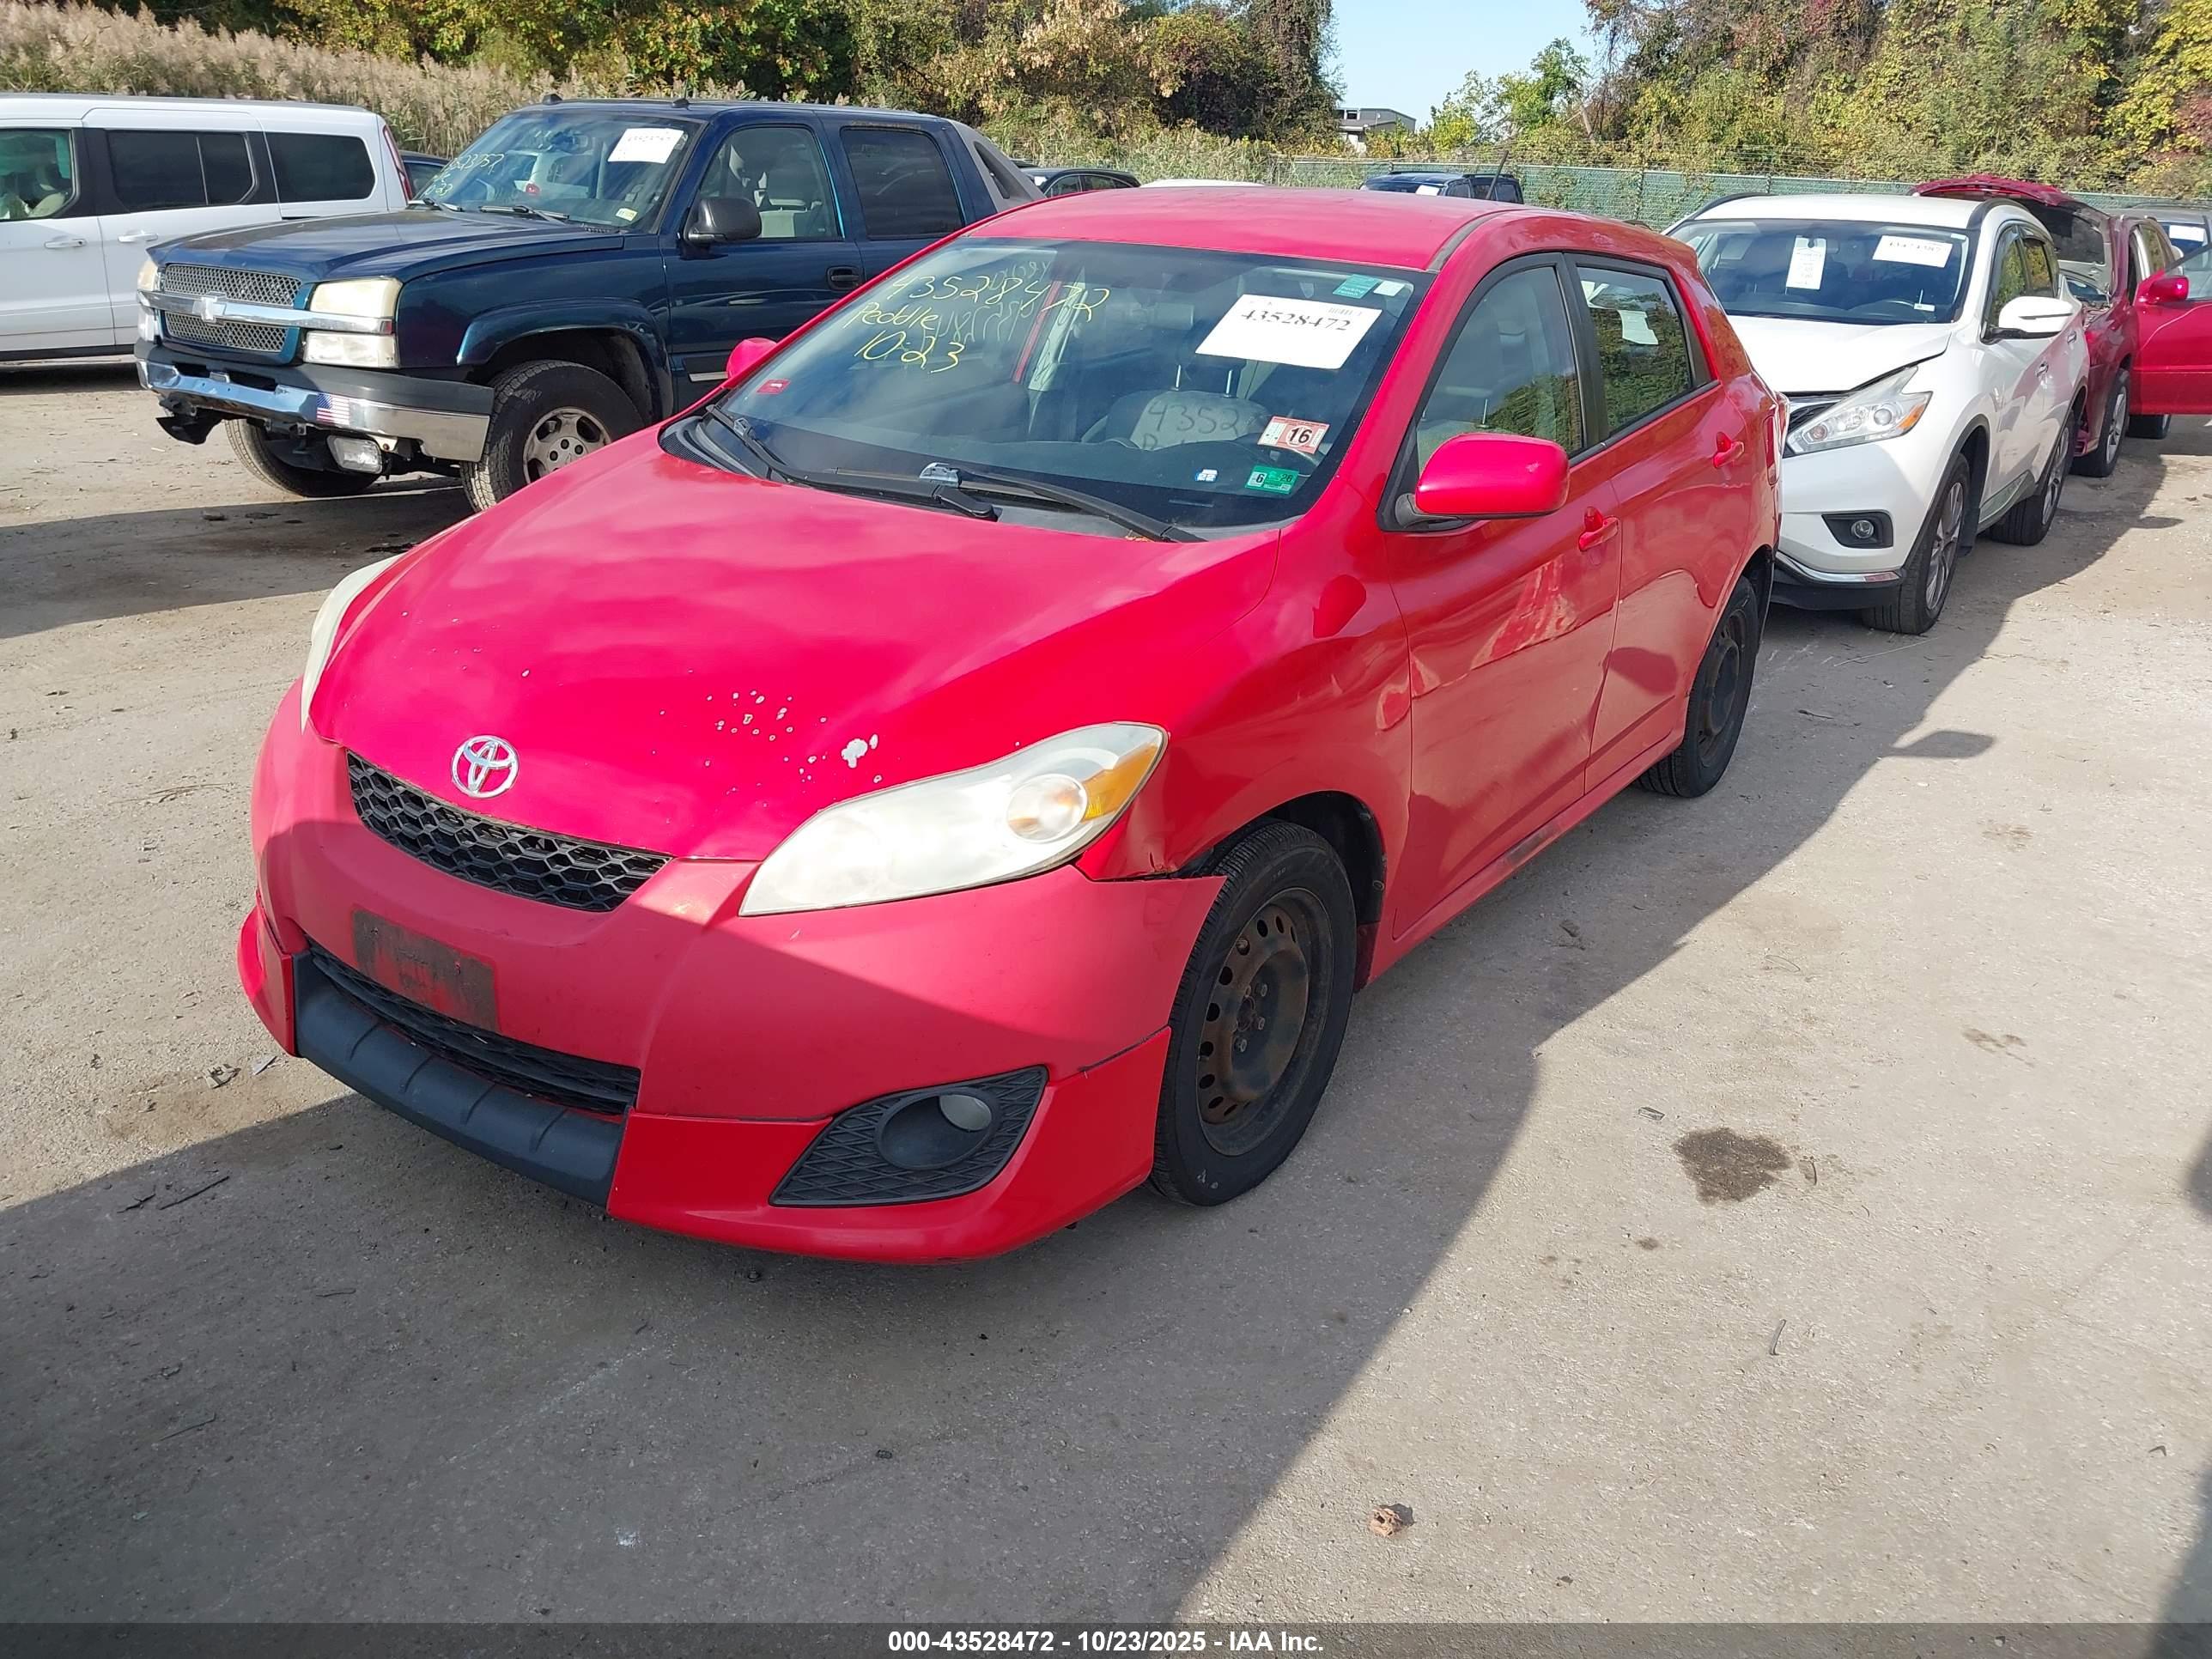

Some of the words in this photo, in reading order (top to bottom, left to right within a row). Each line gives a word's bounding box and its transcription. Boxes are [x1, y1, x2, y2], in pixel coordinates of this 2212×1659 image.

[886, 274, 1111, 323] 43528472
[1240, 309, 1351, 331] 43528472
[1289, 427, 1313, 444] 16
[1255, 473, 1265, 483] 6
